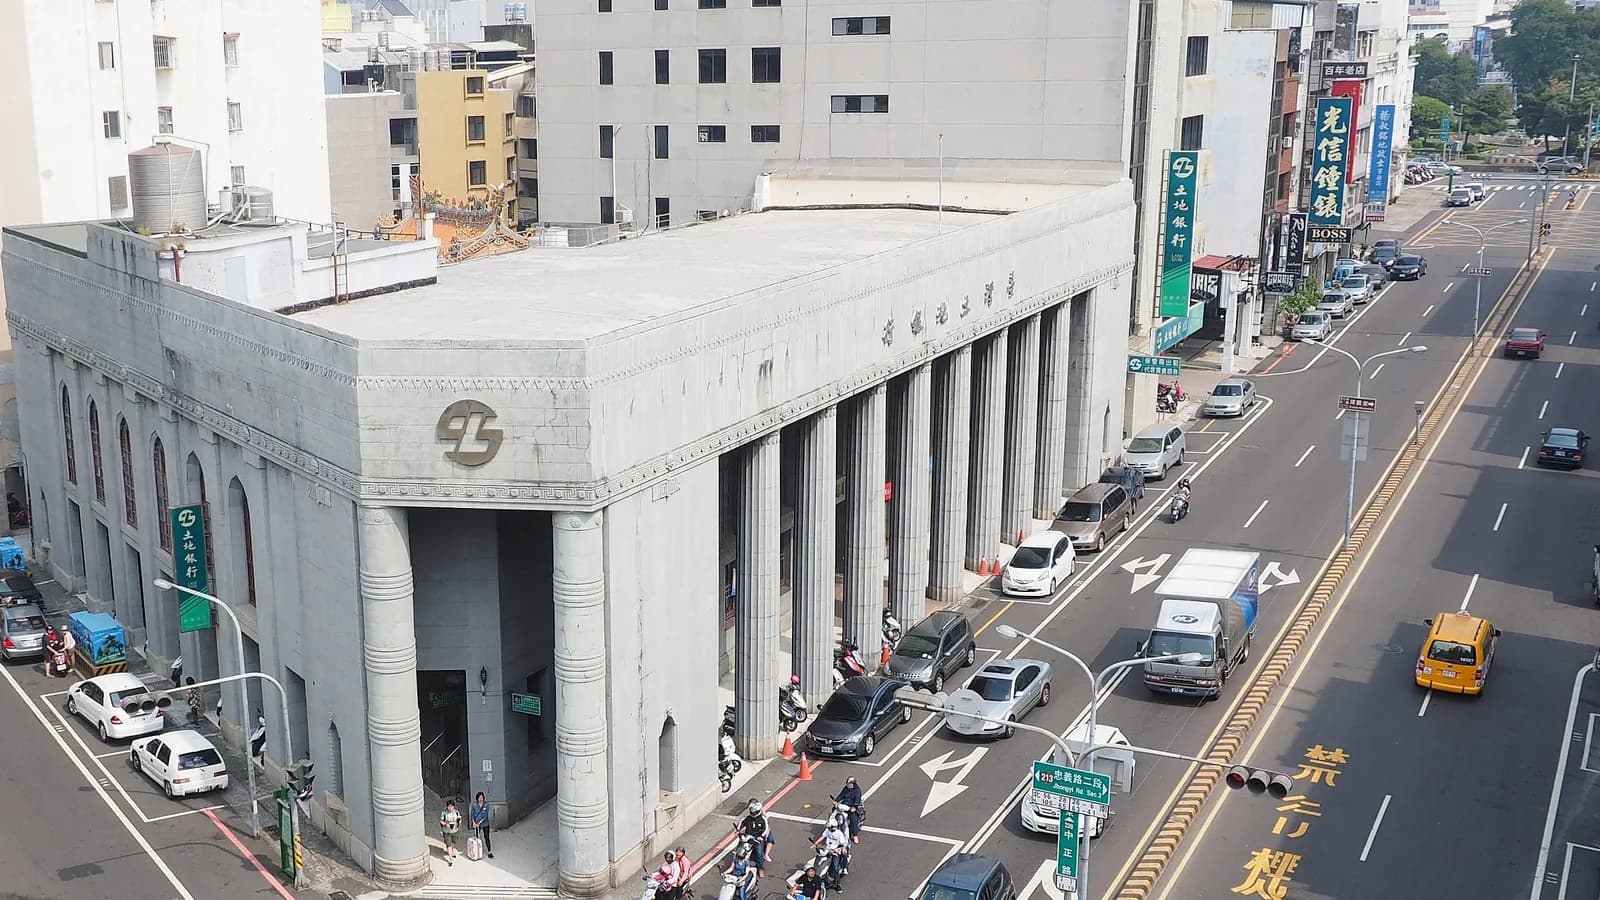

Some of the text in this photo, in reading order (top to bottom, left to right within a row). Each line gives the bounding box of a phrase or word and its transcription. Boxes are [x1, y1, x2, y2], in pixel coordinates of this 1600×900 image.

[1324, 65, 1366, 76] 百年老店
[1314, 106, 1347, 217] 光信鐘錶
[1171, 185, 1188, 247] 土地銀行
[1311, 228, 1347, 239] BOSS
[182, 530, 198, 578] 土地銀行
[1054, 770, 1103, 790] 忠義路二段
[1061, 829, 1074, 876] 中正路
